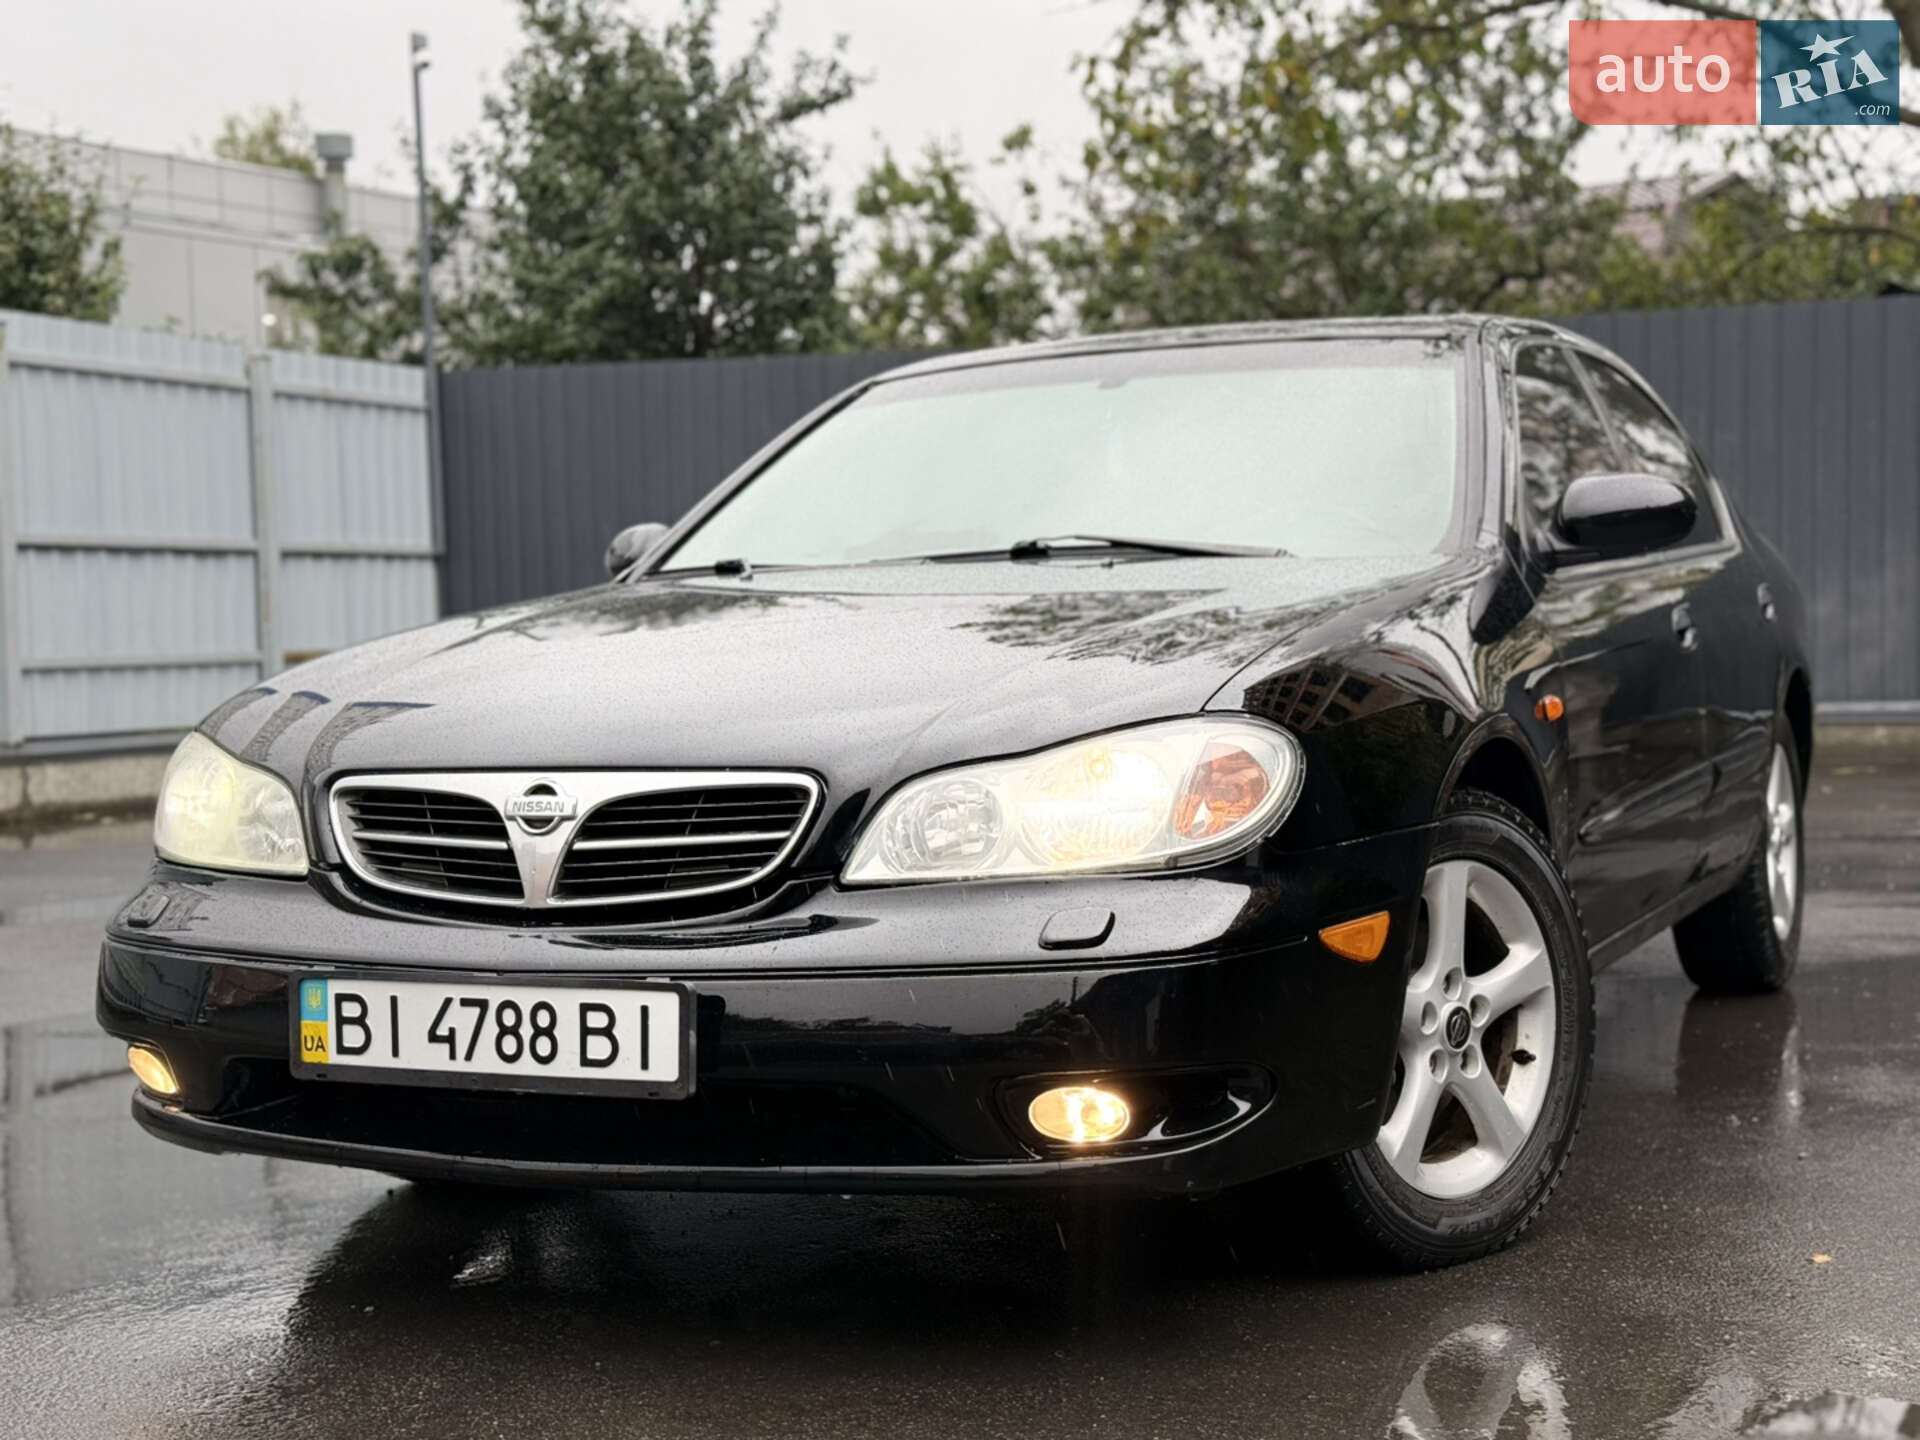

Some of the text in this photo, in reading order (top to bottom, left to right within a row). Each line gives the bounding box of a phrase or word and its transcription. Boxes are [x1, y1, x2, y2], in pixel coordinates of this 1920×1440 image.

[512, 801, 565, 813] NISSAN
[334, 992, 650, 1071] BI 4788 BI
[303, 1035, 326, 1052] UA
